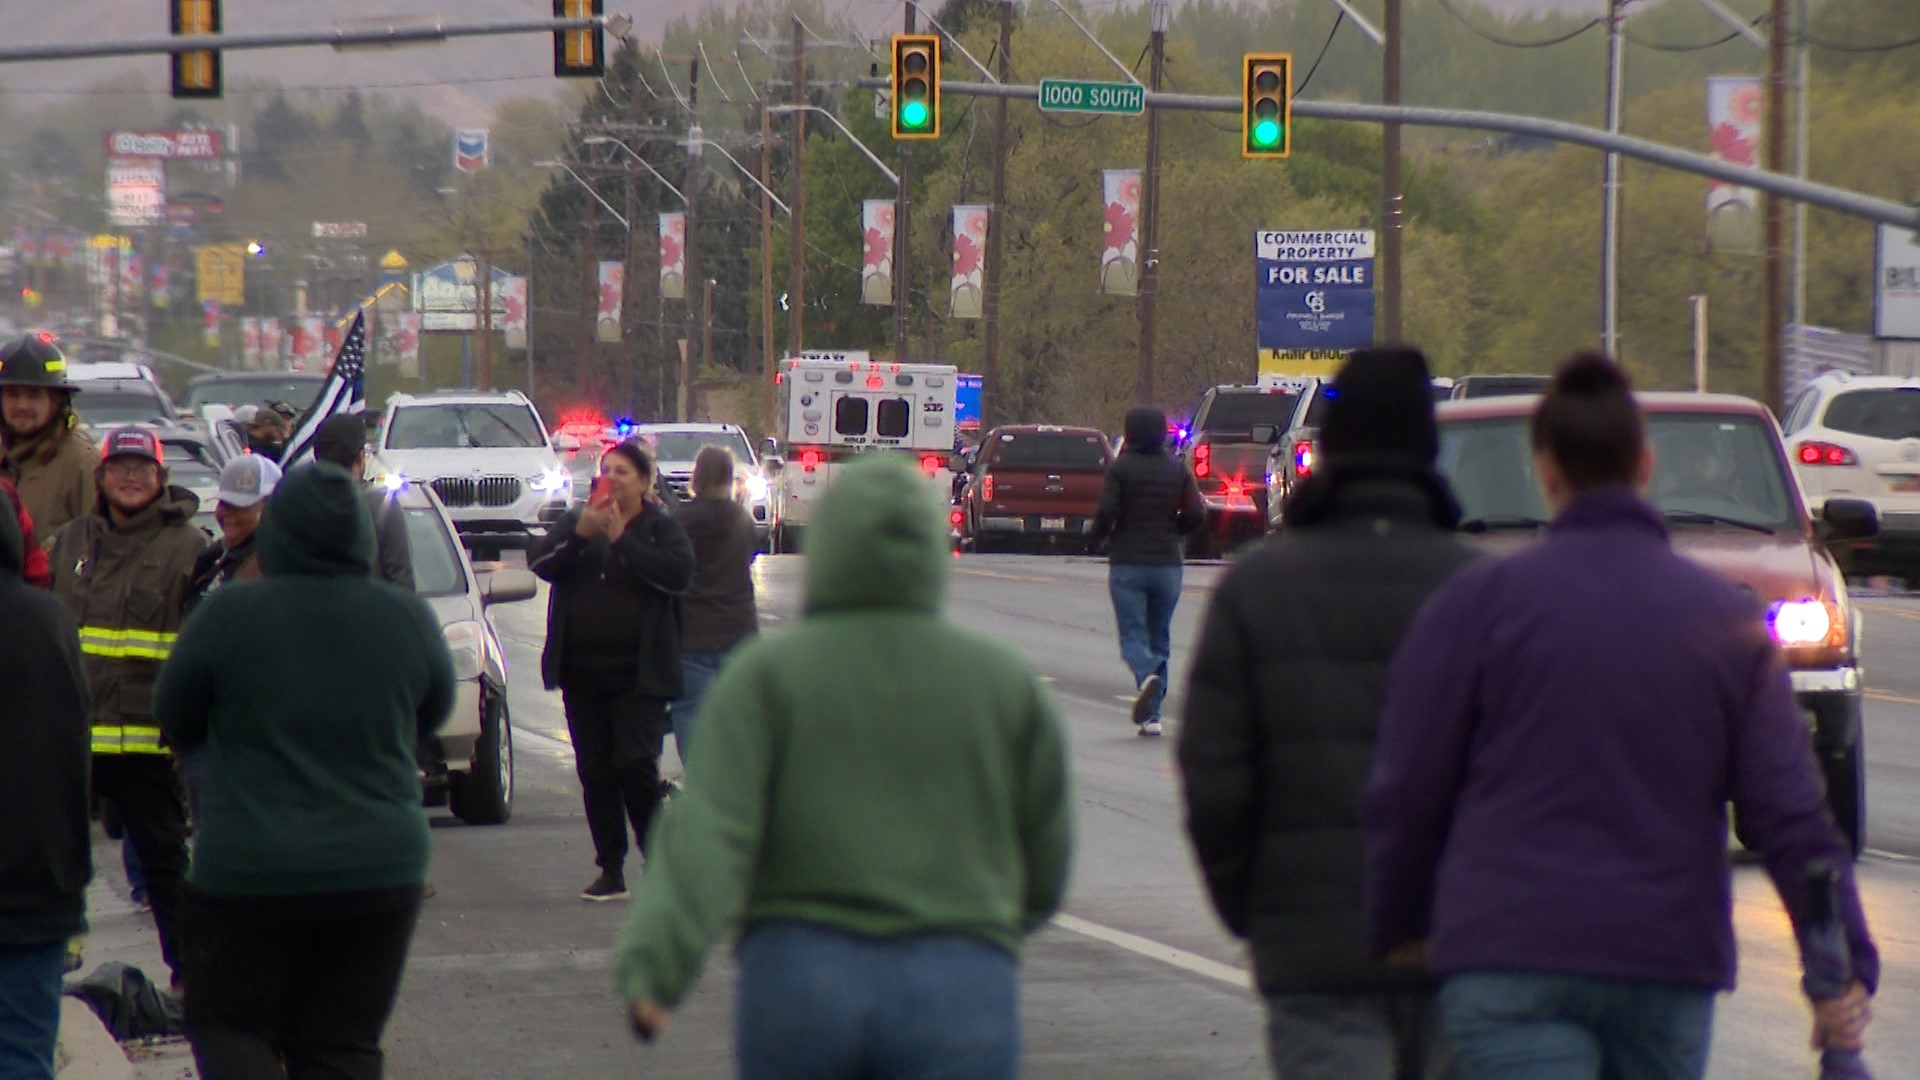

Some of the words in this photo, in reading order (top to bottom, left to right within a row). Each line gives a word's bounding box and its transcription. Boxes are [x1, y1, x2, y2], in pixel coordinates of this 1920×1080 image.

[1045, 86, 1083, 104] 1000
[1089, 88, 1141, 108] SOUTH
[1264, 232, 1367, 244] COMMERCIAL
[1277, 246, 1355, 259] PROPERTY
[1267, 266, 1309, 284] FOR
[1314, 266, 1365, 284] SALE
